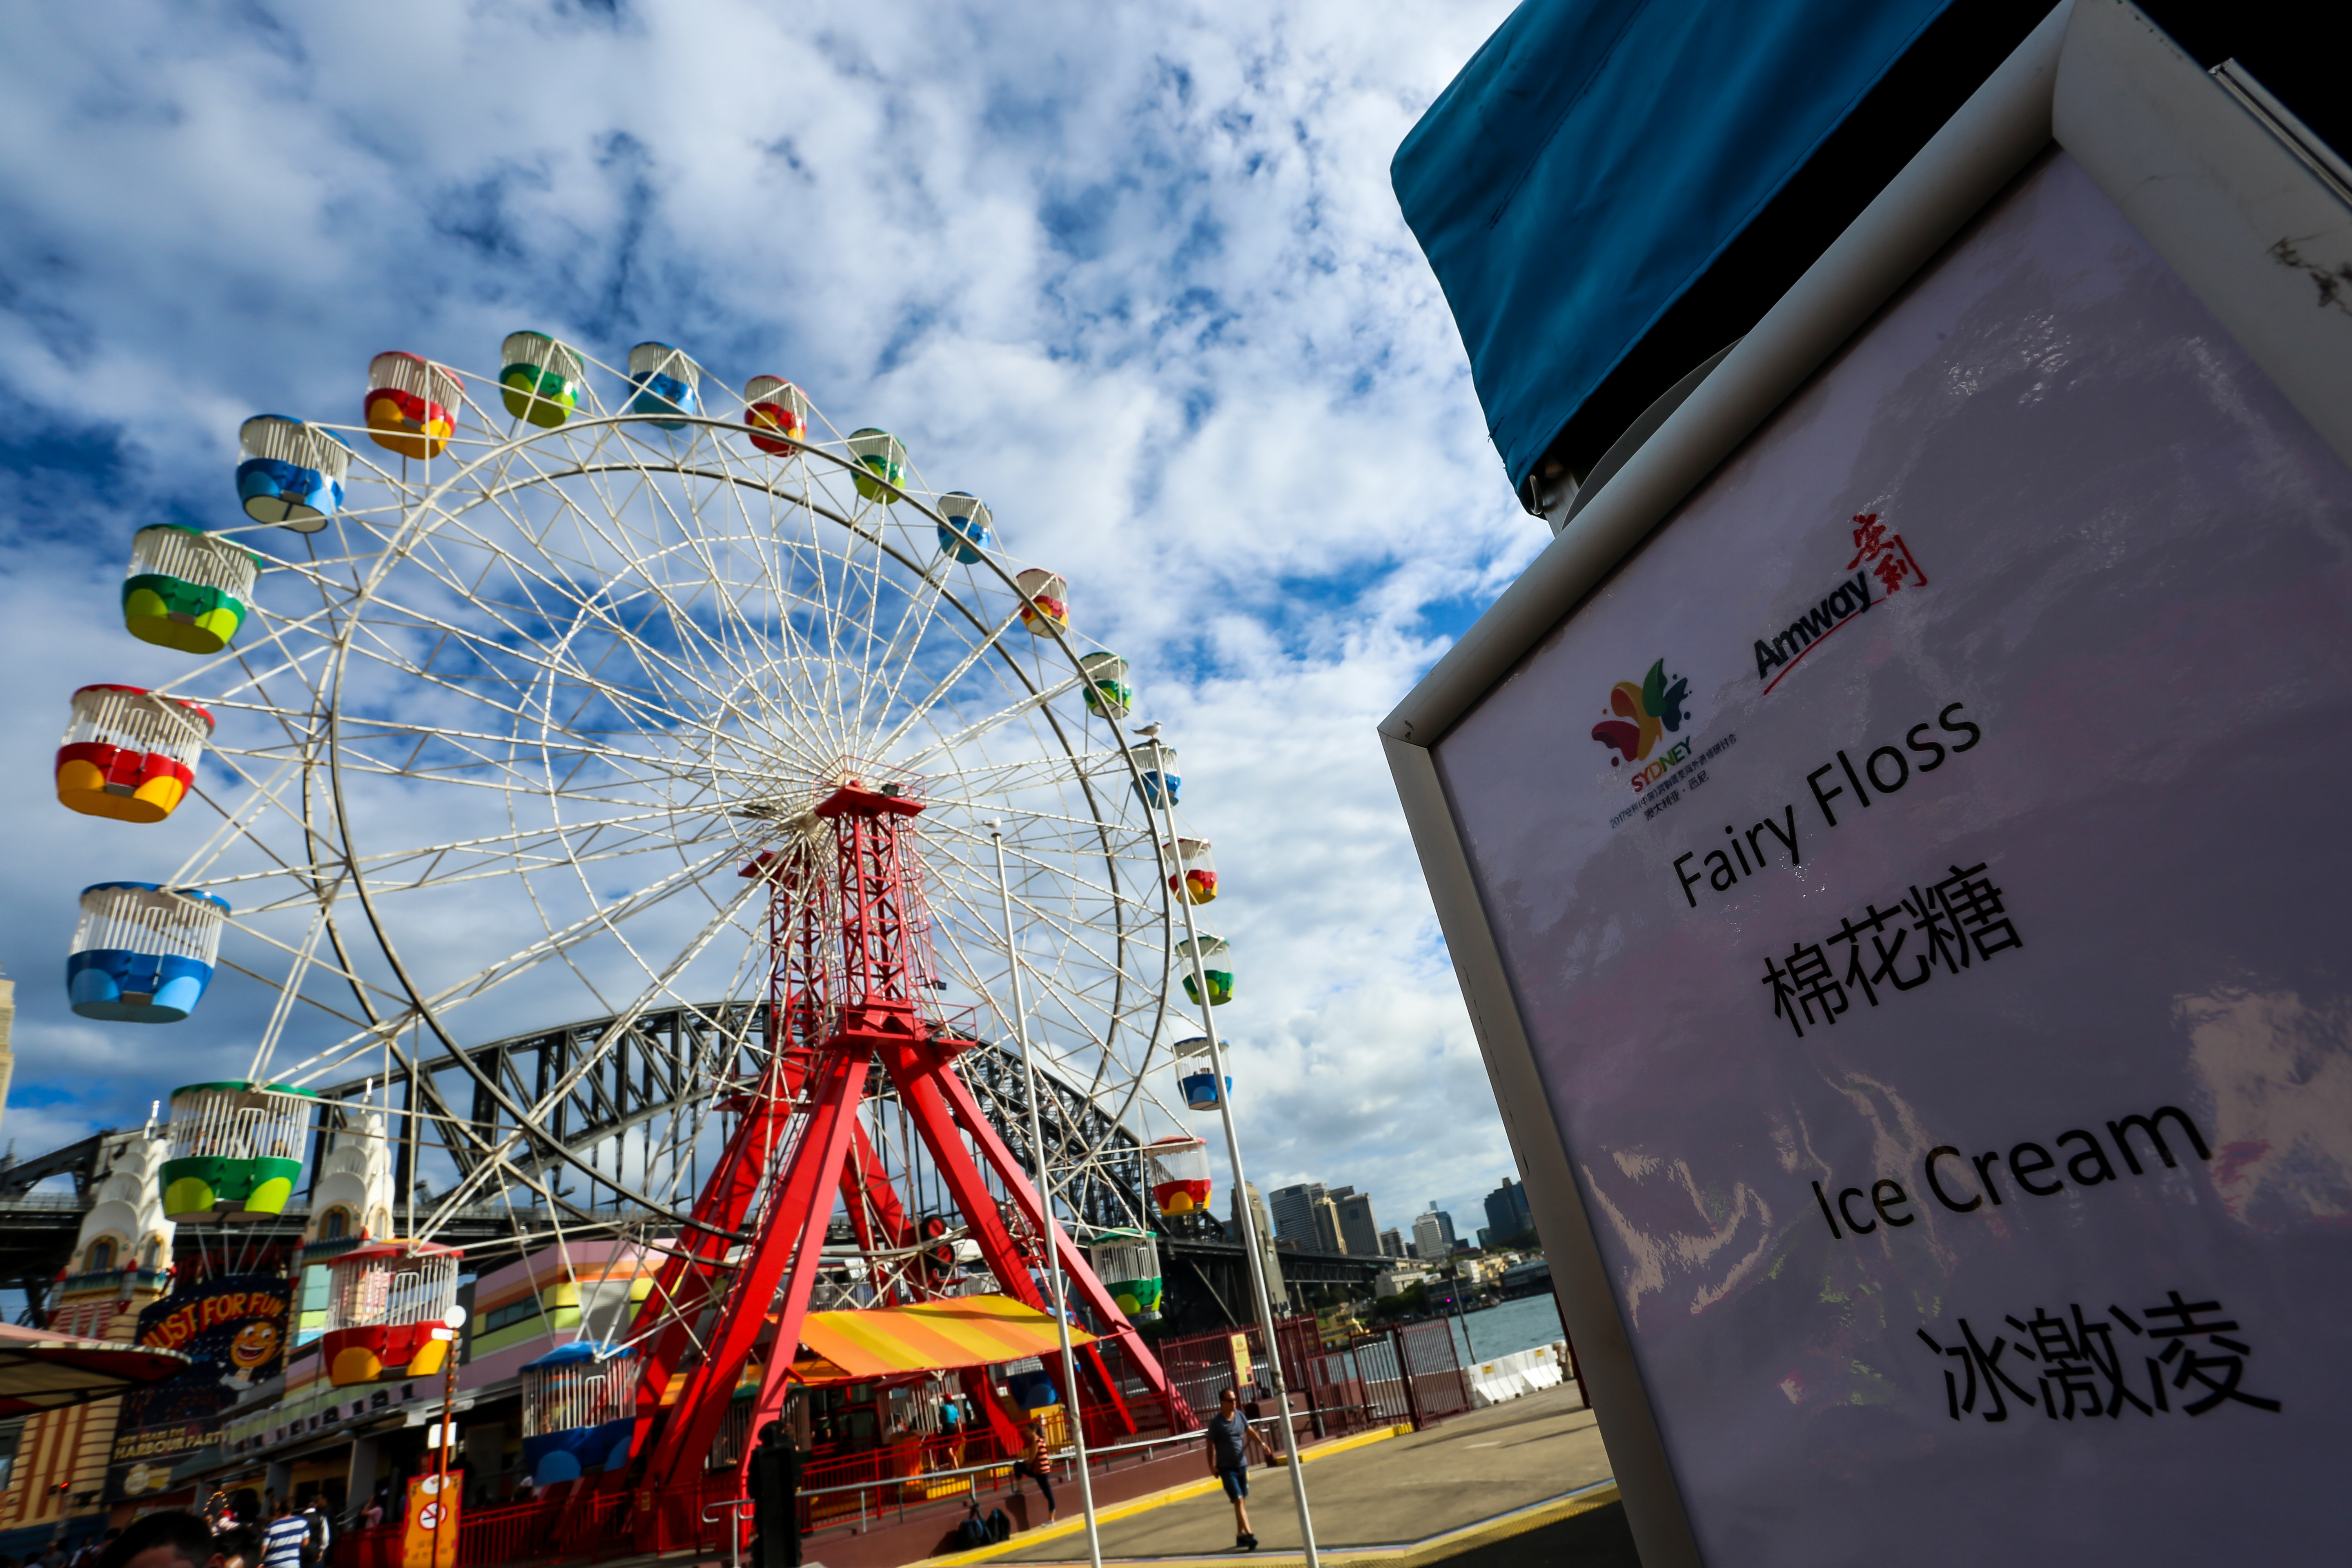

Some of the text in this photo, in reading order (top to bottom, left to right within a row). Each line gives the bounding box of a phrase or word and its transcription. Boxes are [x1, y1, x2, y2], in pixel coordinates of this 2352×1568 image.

[1754, 570, 1871, 680] Amway
[1631, 736, 1691, 792] SYDNEY
[1673, 702, 1981, 908] Fairy Floss
[1761, 862, 2023, 1039] 棉花糖
[1811, 1105, 2213, 1241] Ice Cream
[140, 1292, 285, 1350] JUST FOR FUN
[1916, 1290, 2281, 1423] 冰激凌
[113, 1437, 185, 1460] HARBOUR
